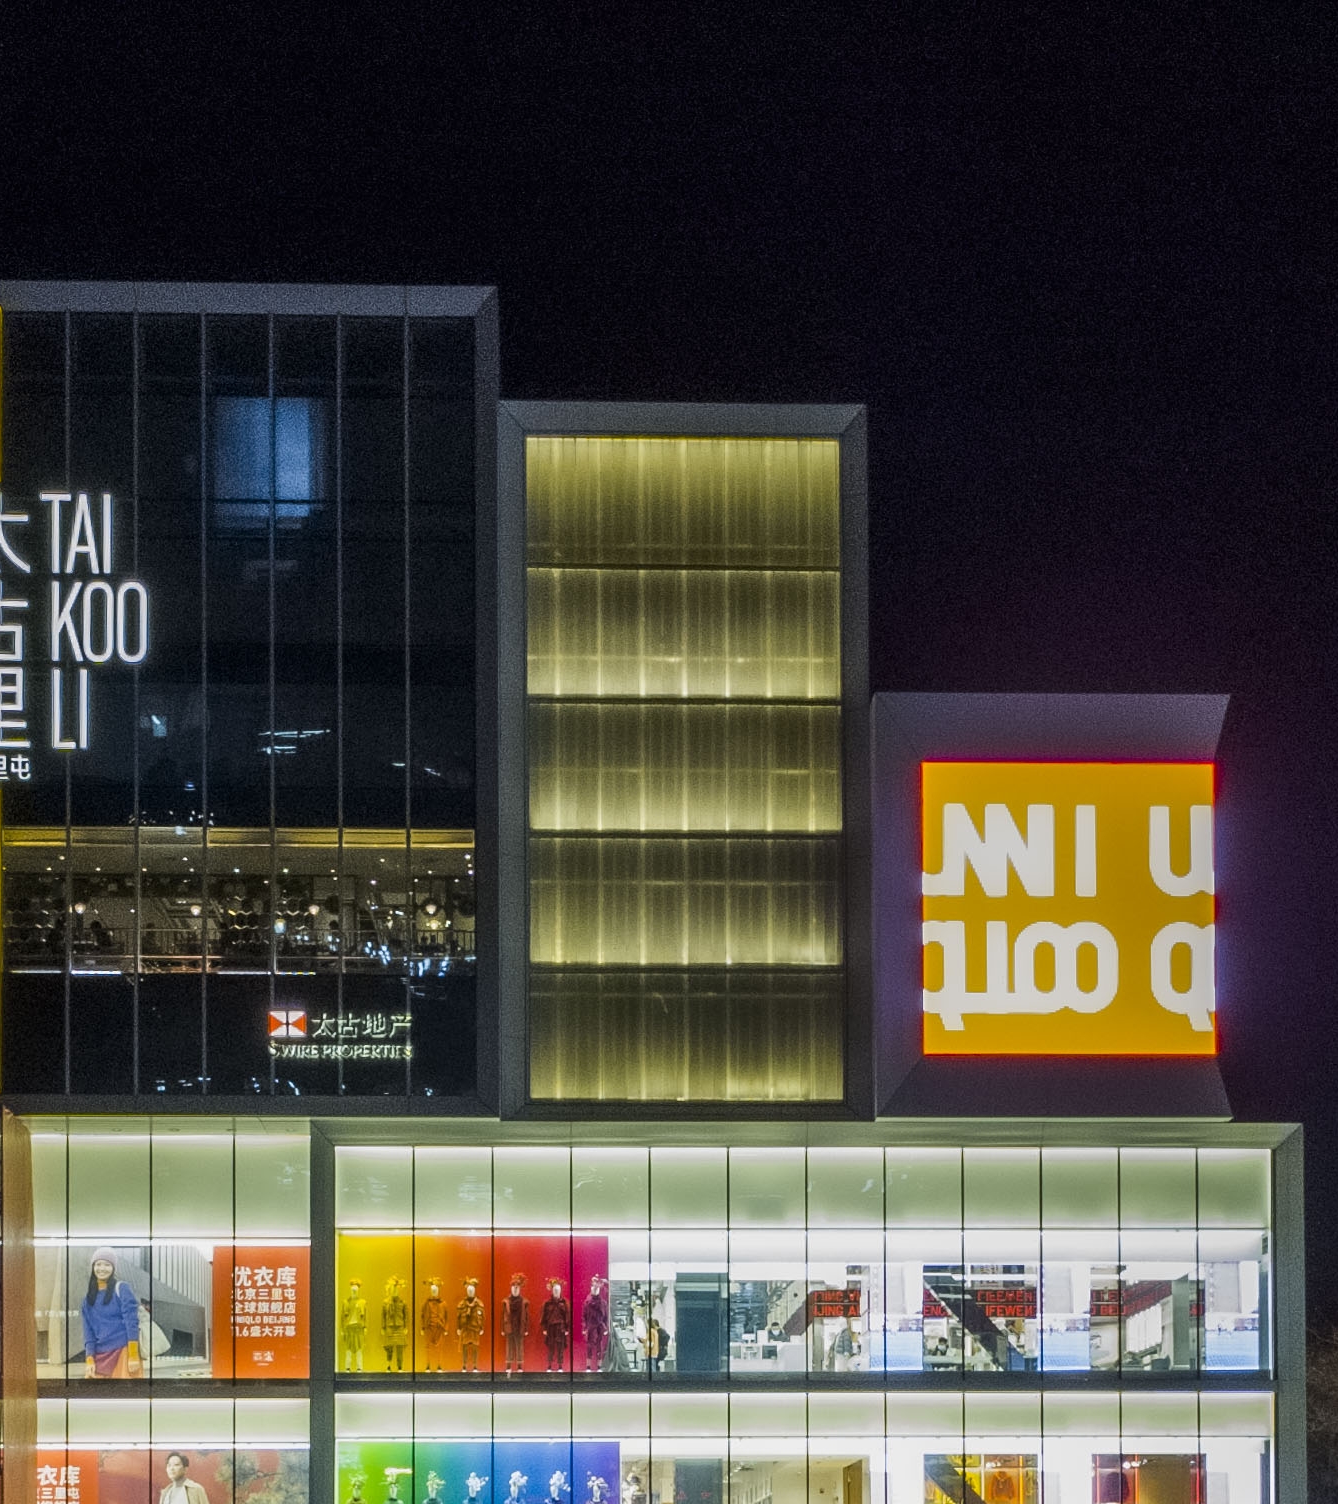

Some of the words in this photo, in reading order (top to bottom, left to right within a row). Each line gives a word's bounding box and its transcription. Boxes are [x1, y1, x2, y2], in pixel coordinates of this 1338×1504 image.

[40, 491, 114, 575] TAI
[51, 580, 149, 664] KOO
[51, 667, 90, 750] LI
[310, 1012, 413, 1039] 太古地产
[267, 1041, 319, 1059] SWIRE
[322, 1043, 414, 1059] PROPERTIES
[231, 1265, 298, 1287] 优衣库
[230, 1288, 297, 1301] 北京三里屯
